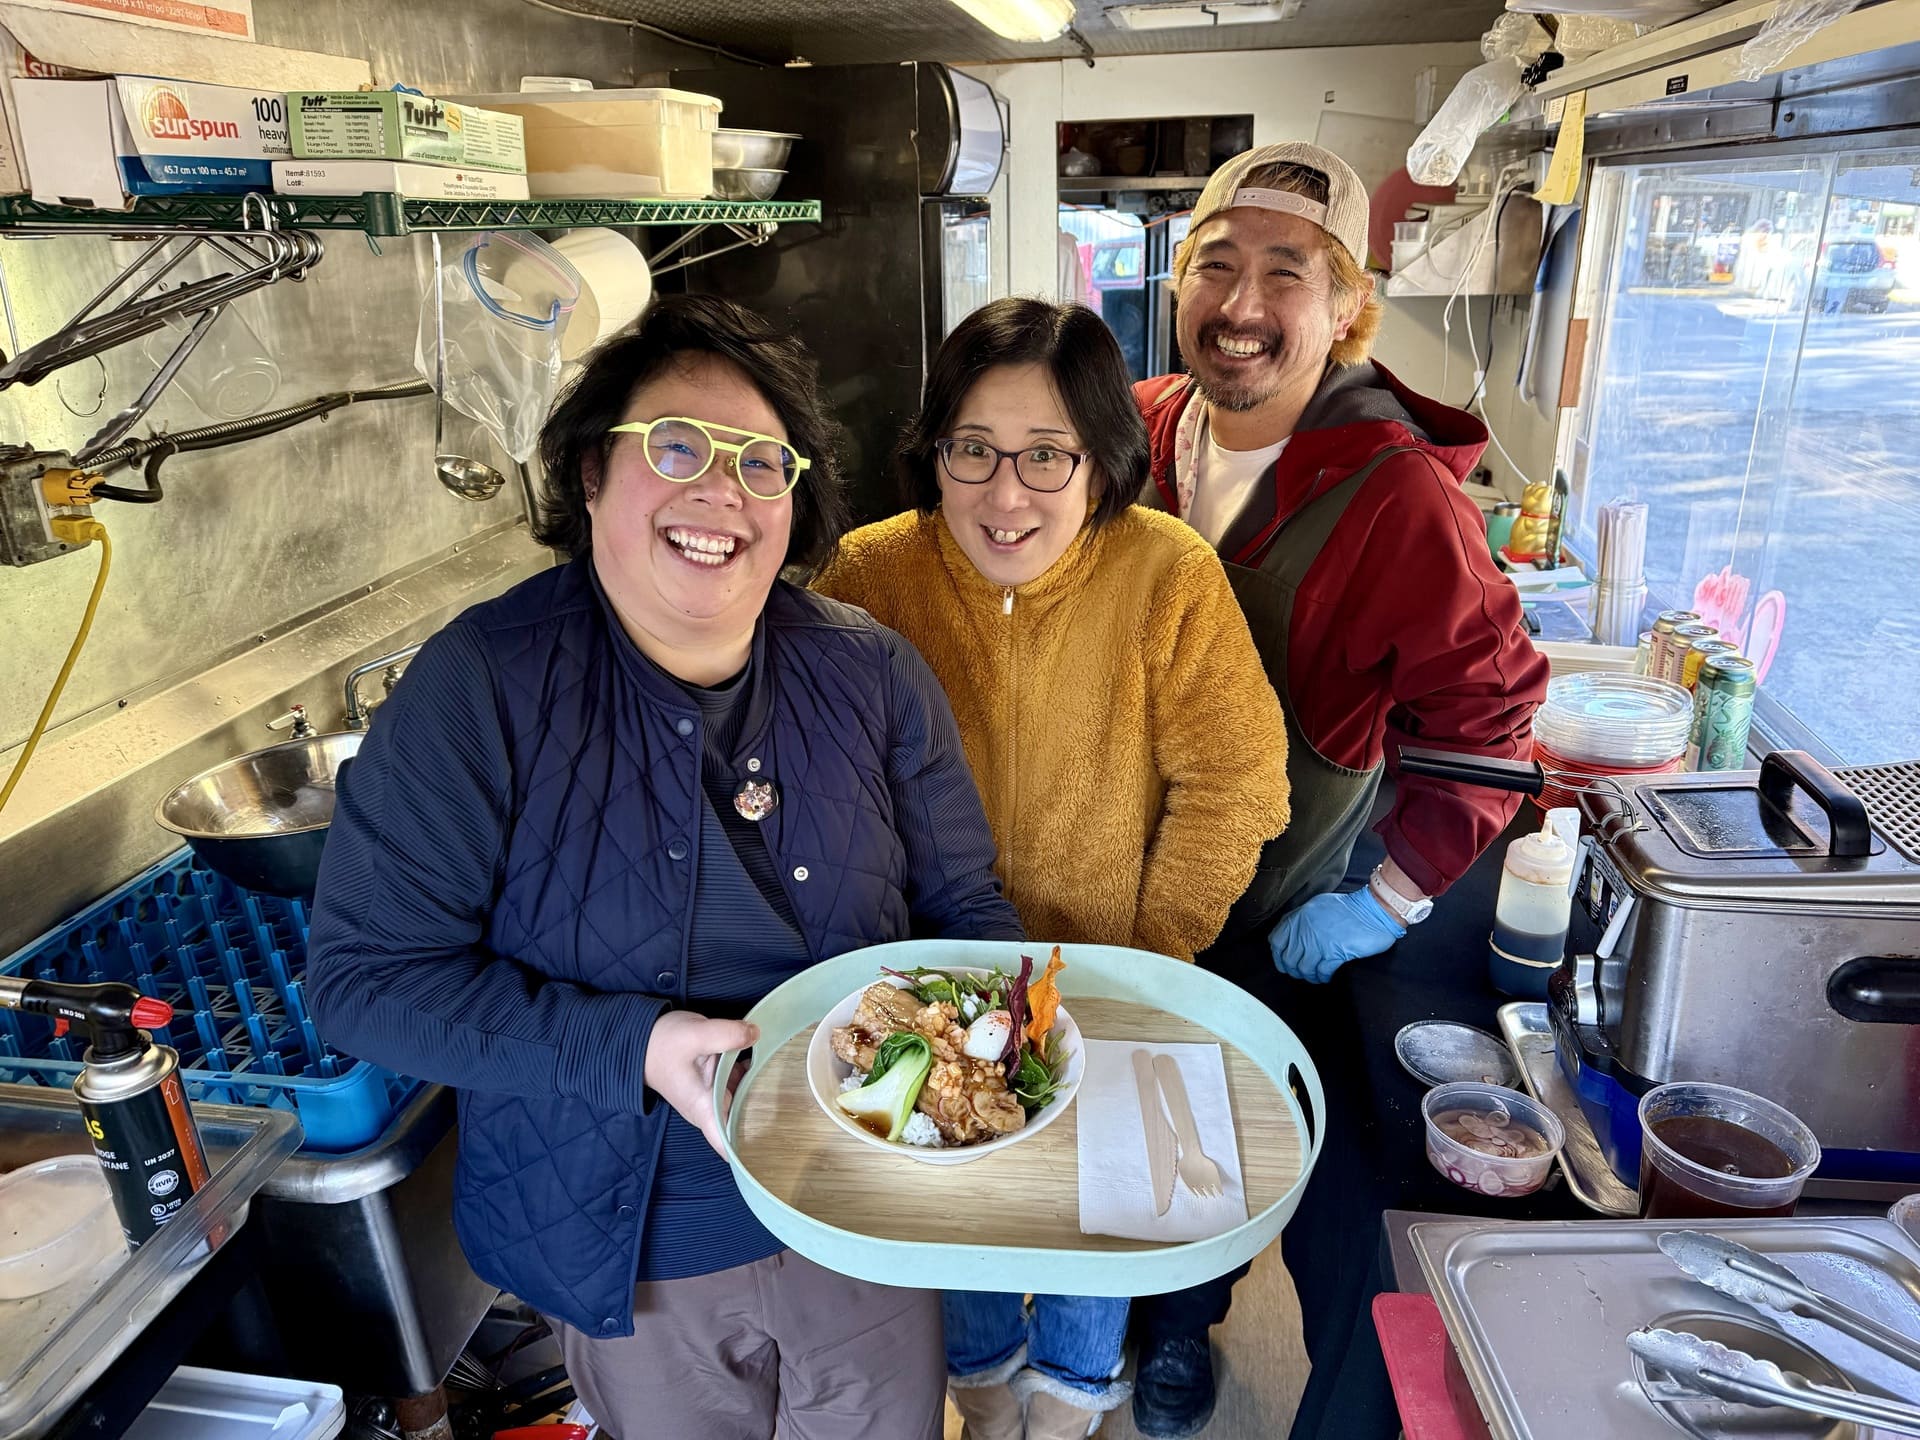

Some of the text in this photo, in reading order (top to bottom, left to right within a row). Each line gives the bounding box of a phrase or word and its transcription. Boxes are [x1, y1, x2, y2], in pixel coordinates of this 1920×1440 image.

[251, 97, 282, 123] 100
[301, 95, 327, 106] Tuff
[404, 101, 444, 126] Tuff
[153, 117, 239, 141] sunspun
[258, 125, 287, 144] heavy
[164, 165, 178, 175] 45.7
[180, 167, 191, 175] cm
[197, 166, 209, 175] 100
[210, 168, 218, 176] m
[224, 166, 237, 176] 45.7
